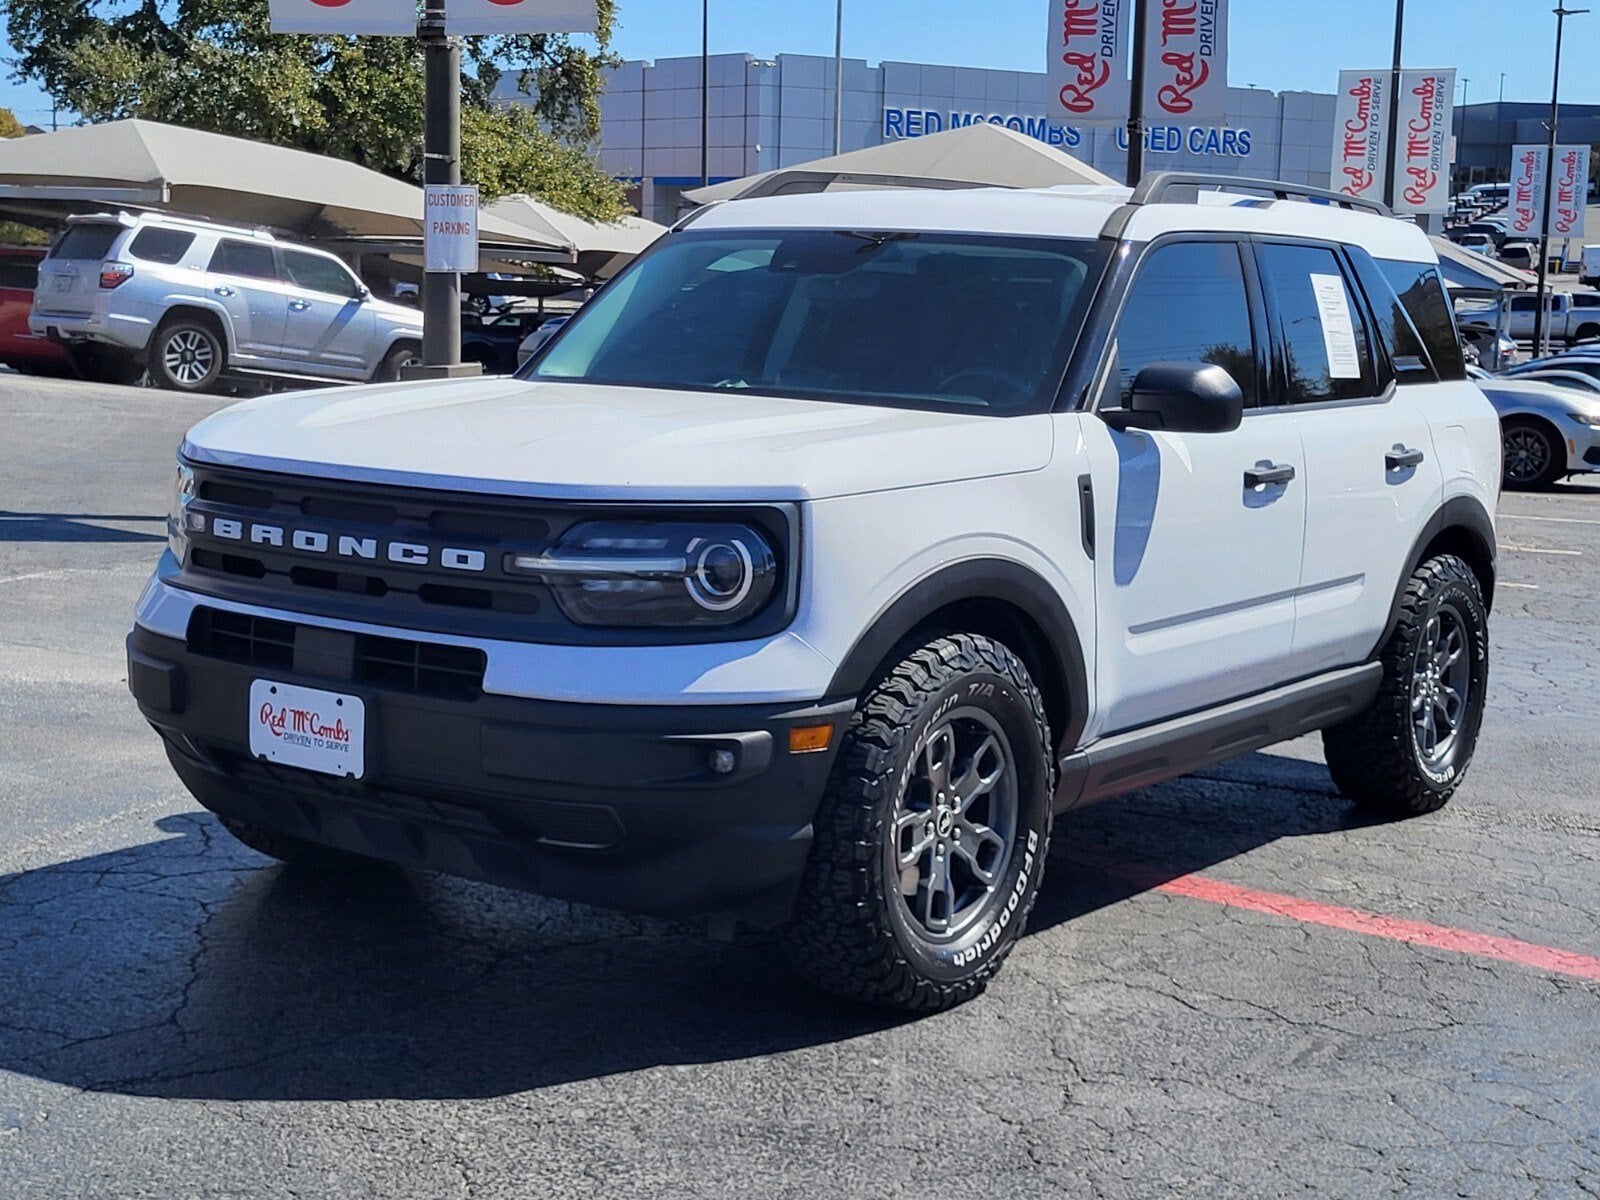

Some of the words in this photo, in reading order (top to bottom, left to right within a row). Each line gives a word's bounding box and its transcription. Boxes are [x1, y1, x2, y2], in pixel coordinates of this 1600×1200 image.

[1060, 52, 1110, 113] Red
[1158, 52, 1209, 113] Red
[1371, 77, 1382, 111] SERVE
[1434, 77, 1446, 111] SERVE
[884, 106, 943, 138] RED
[1343, 78, 1372, 163] McCombs
[1370, 114, 1379, 127] TO
[1407, 77, 1435, 163] McCombs
[1434, 114, 1443, 128] TO
[1186, 127, 1252, 157] CARS
[1367, 130, 1379, 171] DRIVEN
[1431, 130, 1443, 171] DRIVEN
[1340, 166, 1373, 198] Red
[1403, 166, 1436, 205] Red
[1516, 151, 1535, 205] McCombs
[1557, 151, 1576, 205] McCombs
[428, 193, 475, 207] CUSTOMER
[433, 221, 470, 235] PARKING
[1513, 208, 1535, 232] Red
[1555, 208, 1577, 233] Red
[213, 518, 485, 571] BRONCO
[967, 683, 995, 698] T/A
[260, 702, 286, 736] Red
[289, 708, 350, 742] McCombs
[283, 732, 312, 746] DRIVEN
[314, 738, 325, 748] TO
[326, 740, 350, 753] SERVE
[953, 829, 1038, 966] BFGoodrich
